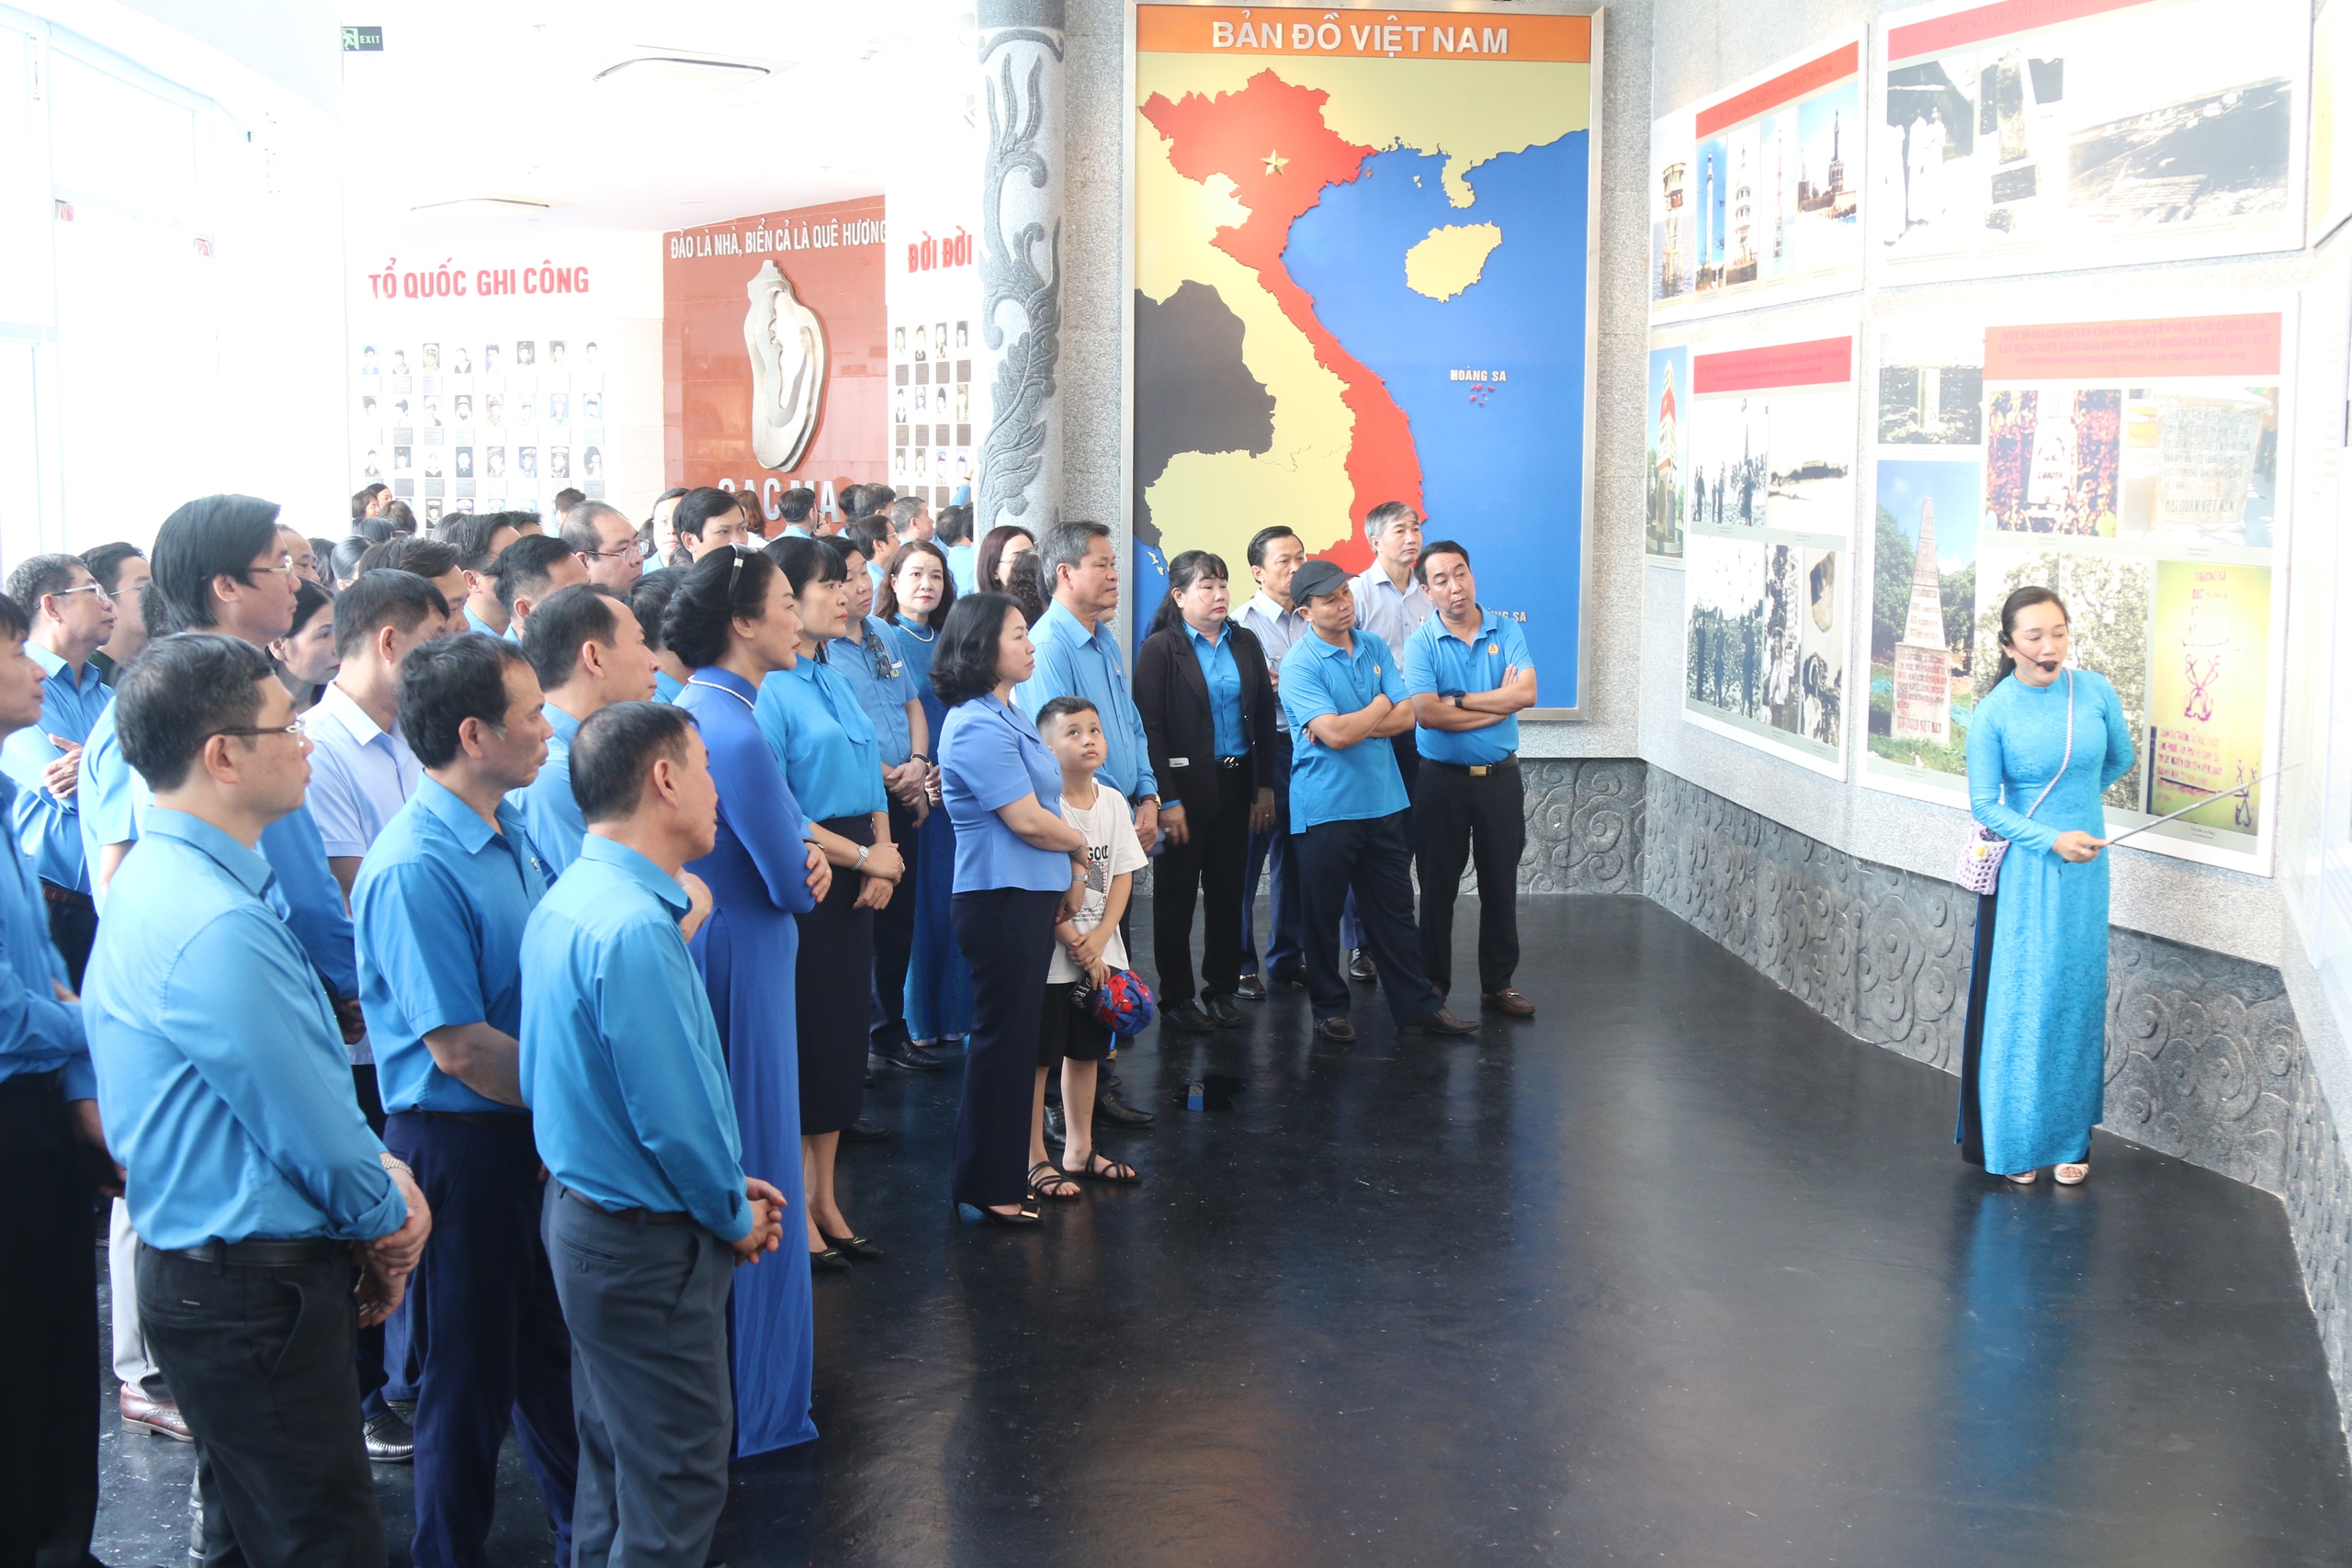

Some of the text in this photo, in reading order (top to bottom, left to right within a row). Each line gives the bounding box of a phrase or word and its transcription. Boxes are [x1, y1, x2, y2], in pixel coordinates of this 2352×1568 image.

[359, 35, 380, 44] EXIT
[1212, 9, 1508, 57] BẢN ĐỒ VIỆT NAM
[671, 218, 886, 259] ĐẢO LÀ NHÀ, BIỂN CẢ LÀ QUÊ HƯƠNG
[908, 225, 972, 273] ĐỜI ĐỜI
[368, 257, 589, 299] TỔ QUỐC GHI CÔNG
[2172, 321, 2192, 334] VIỆT
[2194, 321, 2214, 332] NAM
[1450, 366, 1507, 382] HOÀNG SA
[1513, 611, 1527, 622] SA
